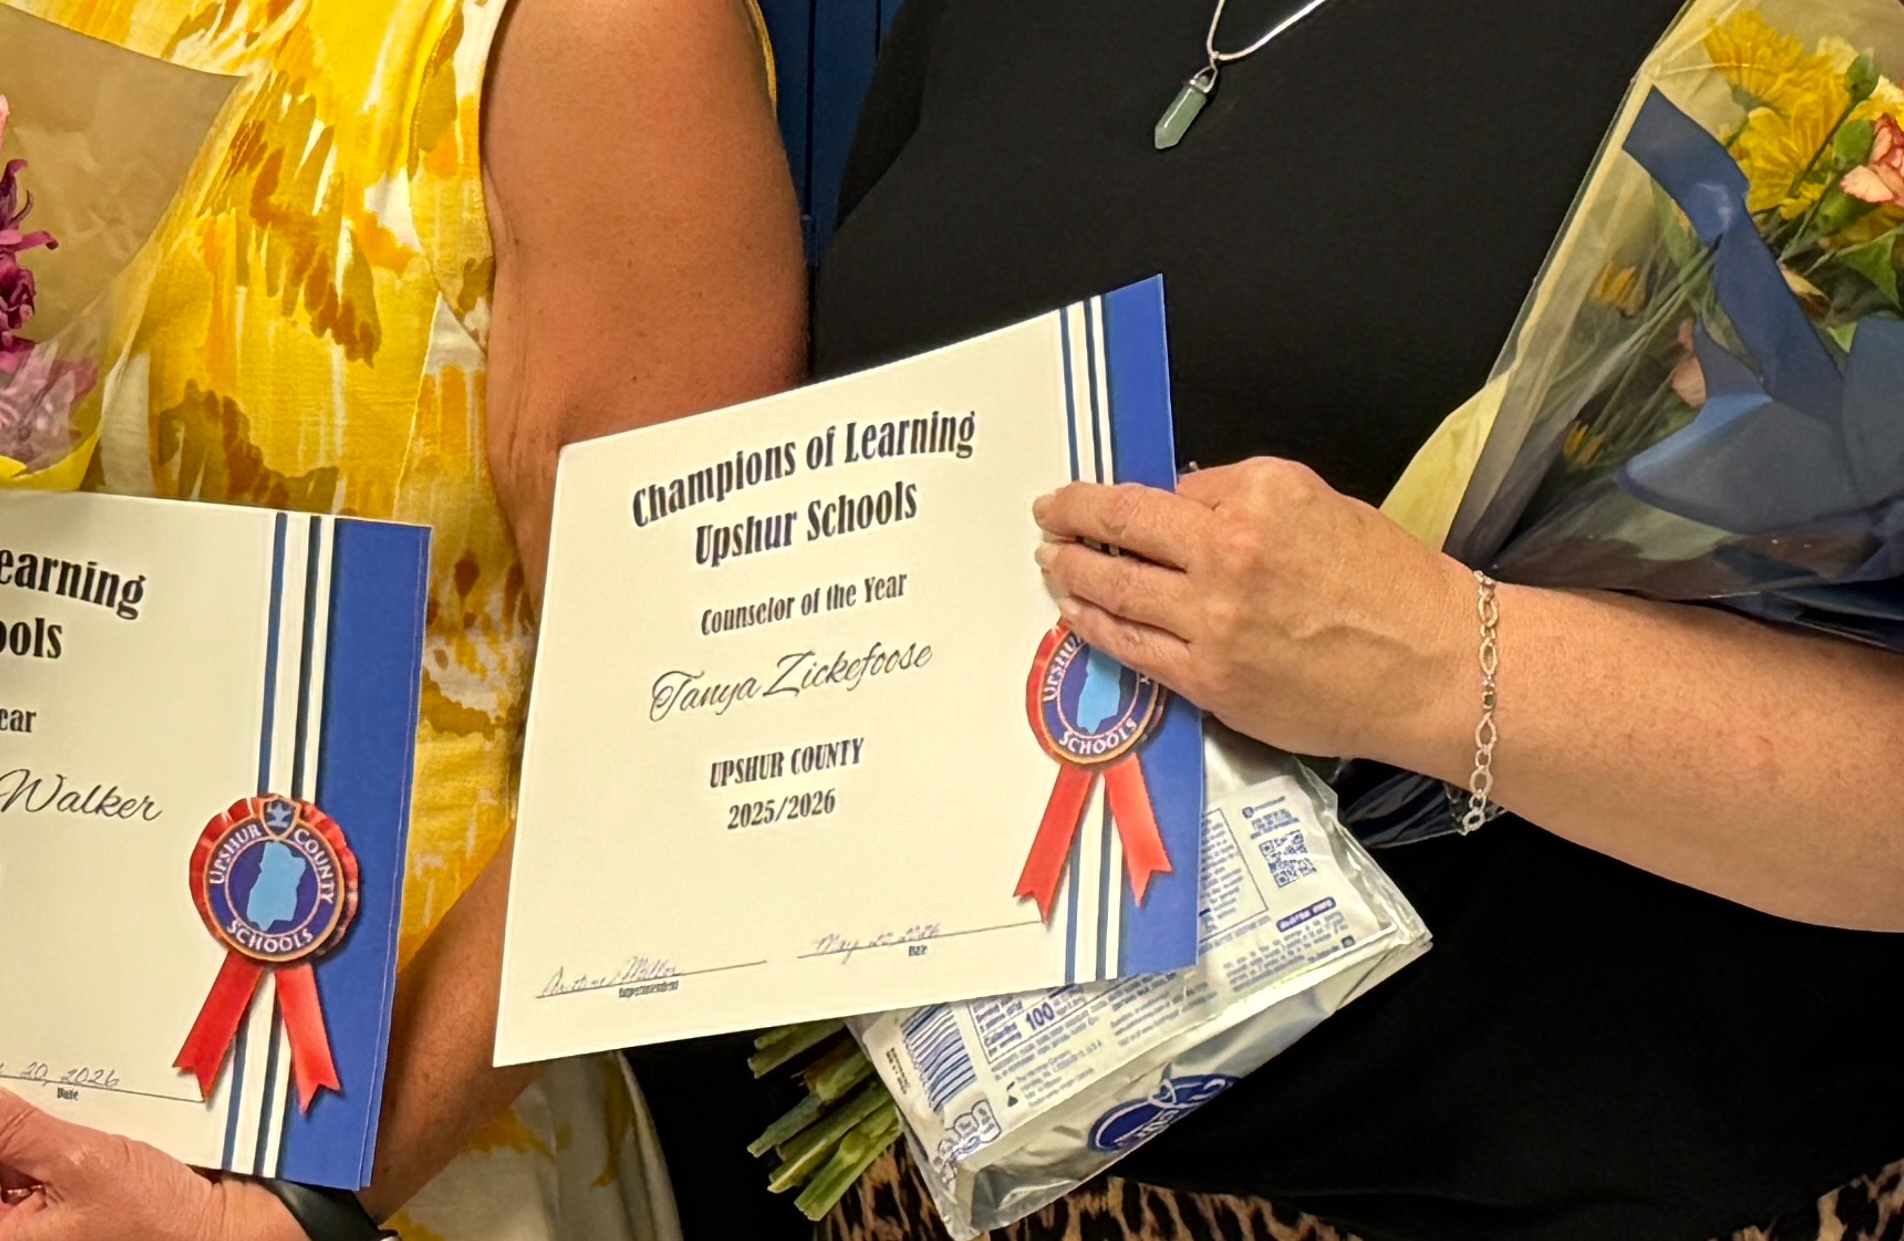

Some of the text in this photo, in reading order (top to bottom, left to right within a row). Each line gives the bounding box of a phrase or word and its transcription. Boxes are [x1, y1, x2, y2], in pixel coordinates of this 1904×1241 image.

[633, 411, 975, 528] Champions of Learning
[696, 481, 917, 567] Upshur Schools
[701, 574, 907, 635] Counselor of the Year
[650, 642, 932, 722] Tanya Zickefoose
[1043, 634, 1084, 702] UPSHU
[710, 737, 864, 788] UPSHUR COUNTY
[1059, 717, 1137, 754] SCHOOLS
[727, 788, 835, 830] 2025/2026
[209, 824, 262, 884] UPSHUR
[294, 829, 334, 904] COUNTY
[227, 920, 313, 952] SCHOOLS
[1025, 1002, 1055, 1030] 100
